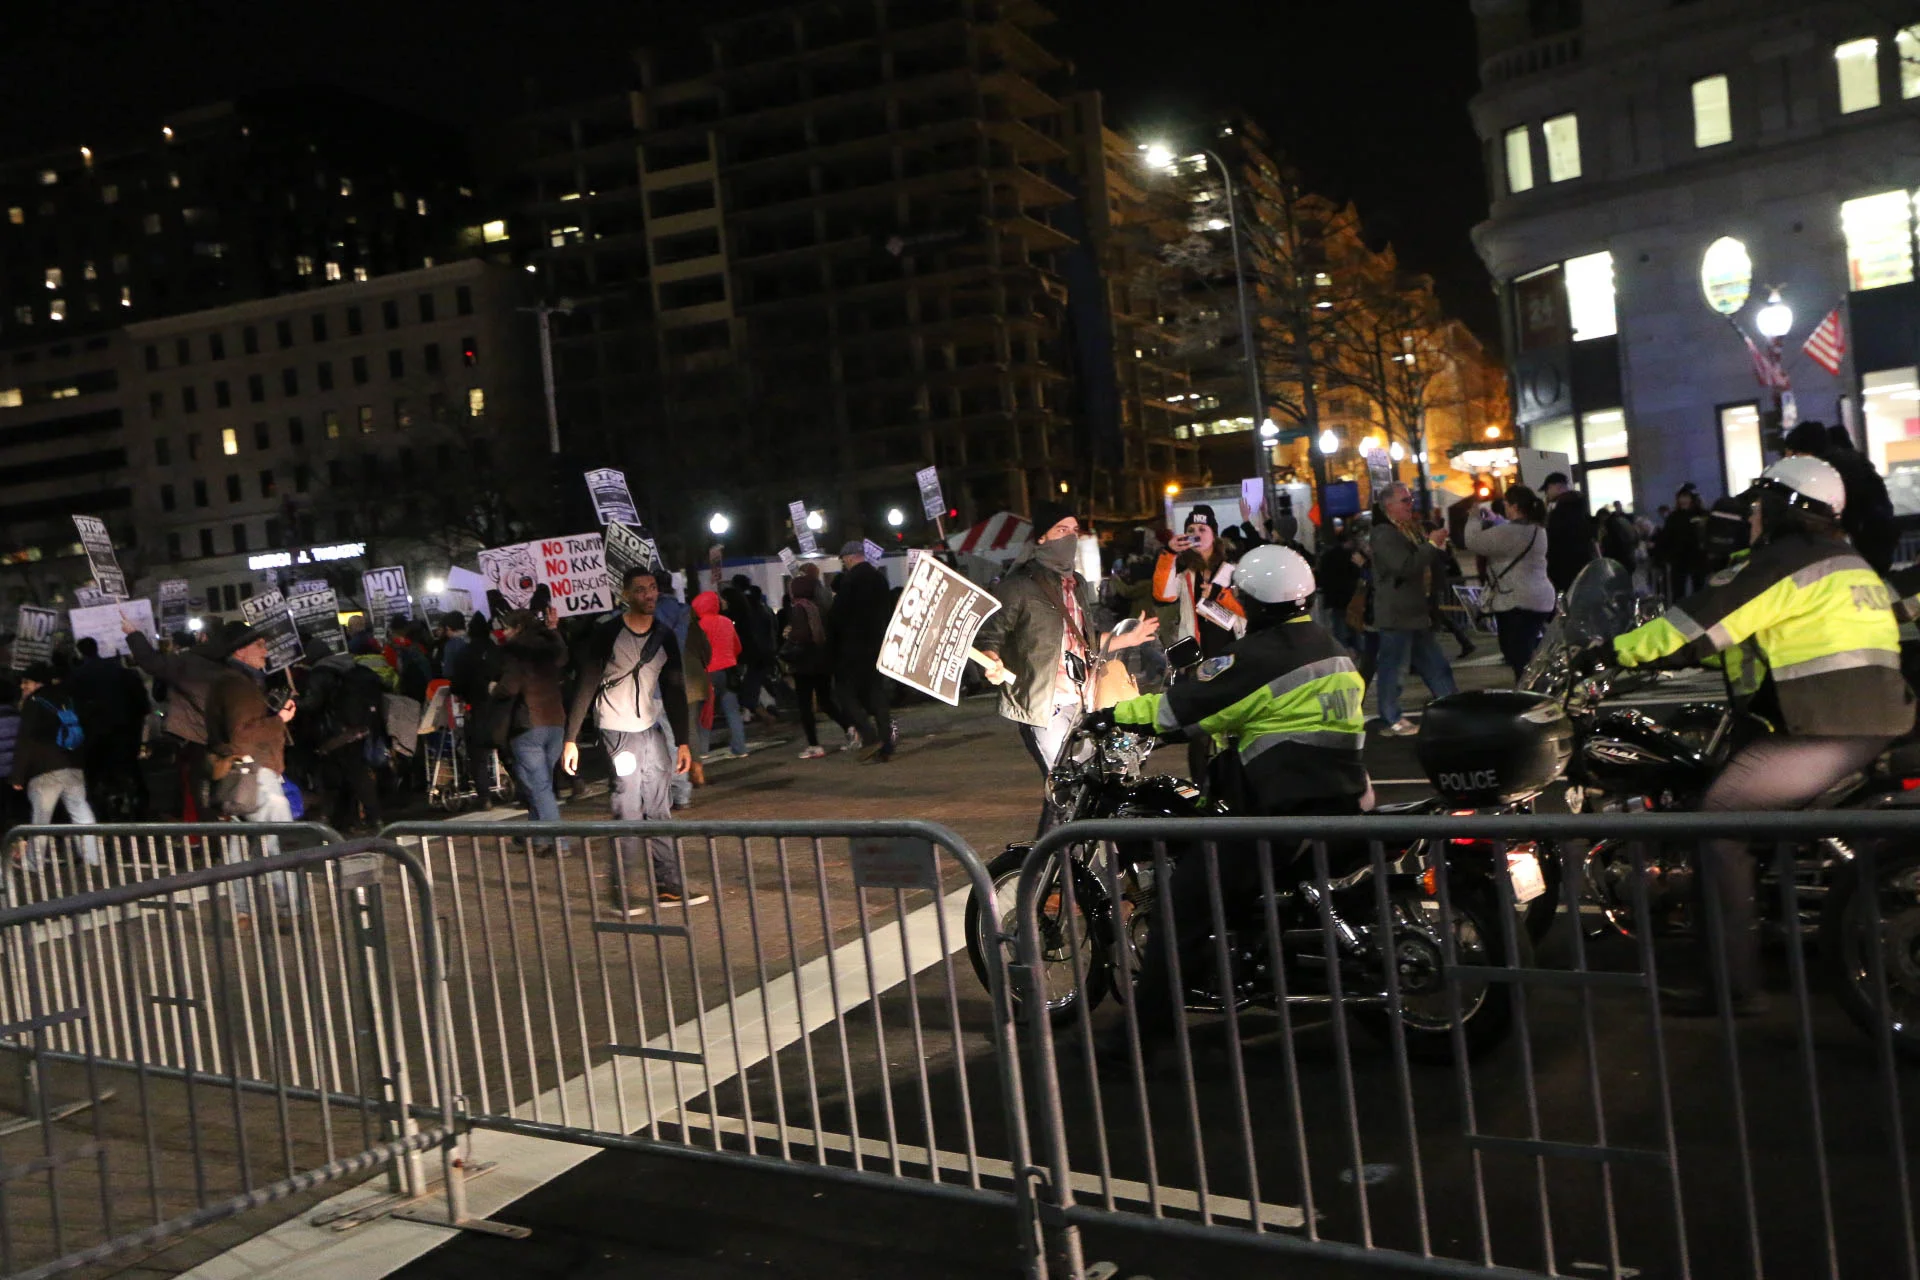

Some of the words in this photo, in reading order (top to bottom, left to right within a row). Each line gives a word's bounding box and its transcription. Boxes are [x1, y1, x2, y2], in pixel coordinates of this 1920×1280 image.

[77, 518, 105, 534] STOP
[1193, 514, 1208, 524] NO!
[541, 541, 564, 557] NO
[611, 522, 650, 556] STOP
[545, 558, 568, 577] NO
[570, 555, 603, 573] KKK
[365, 570, 404, 599] NO!
[550, 578, 573, 598] NO
[573, 573, 609, 593] FASCIST
[244, 592, 282, 616] STOP
[290, 591, 334, 610] STOP
[565, 593, 604, 612] USA
[882, 560, 931, 668] STOP
[955, 618, 964, 631] A
[19, 611, 54, 641] NO!
[947, 658, 958, 679] NO!
[1438, 769, 1500, 791] POLICE
